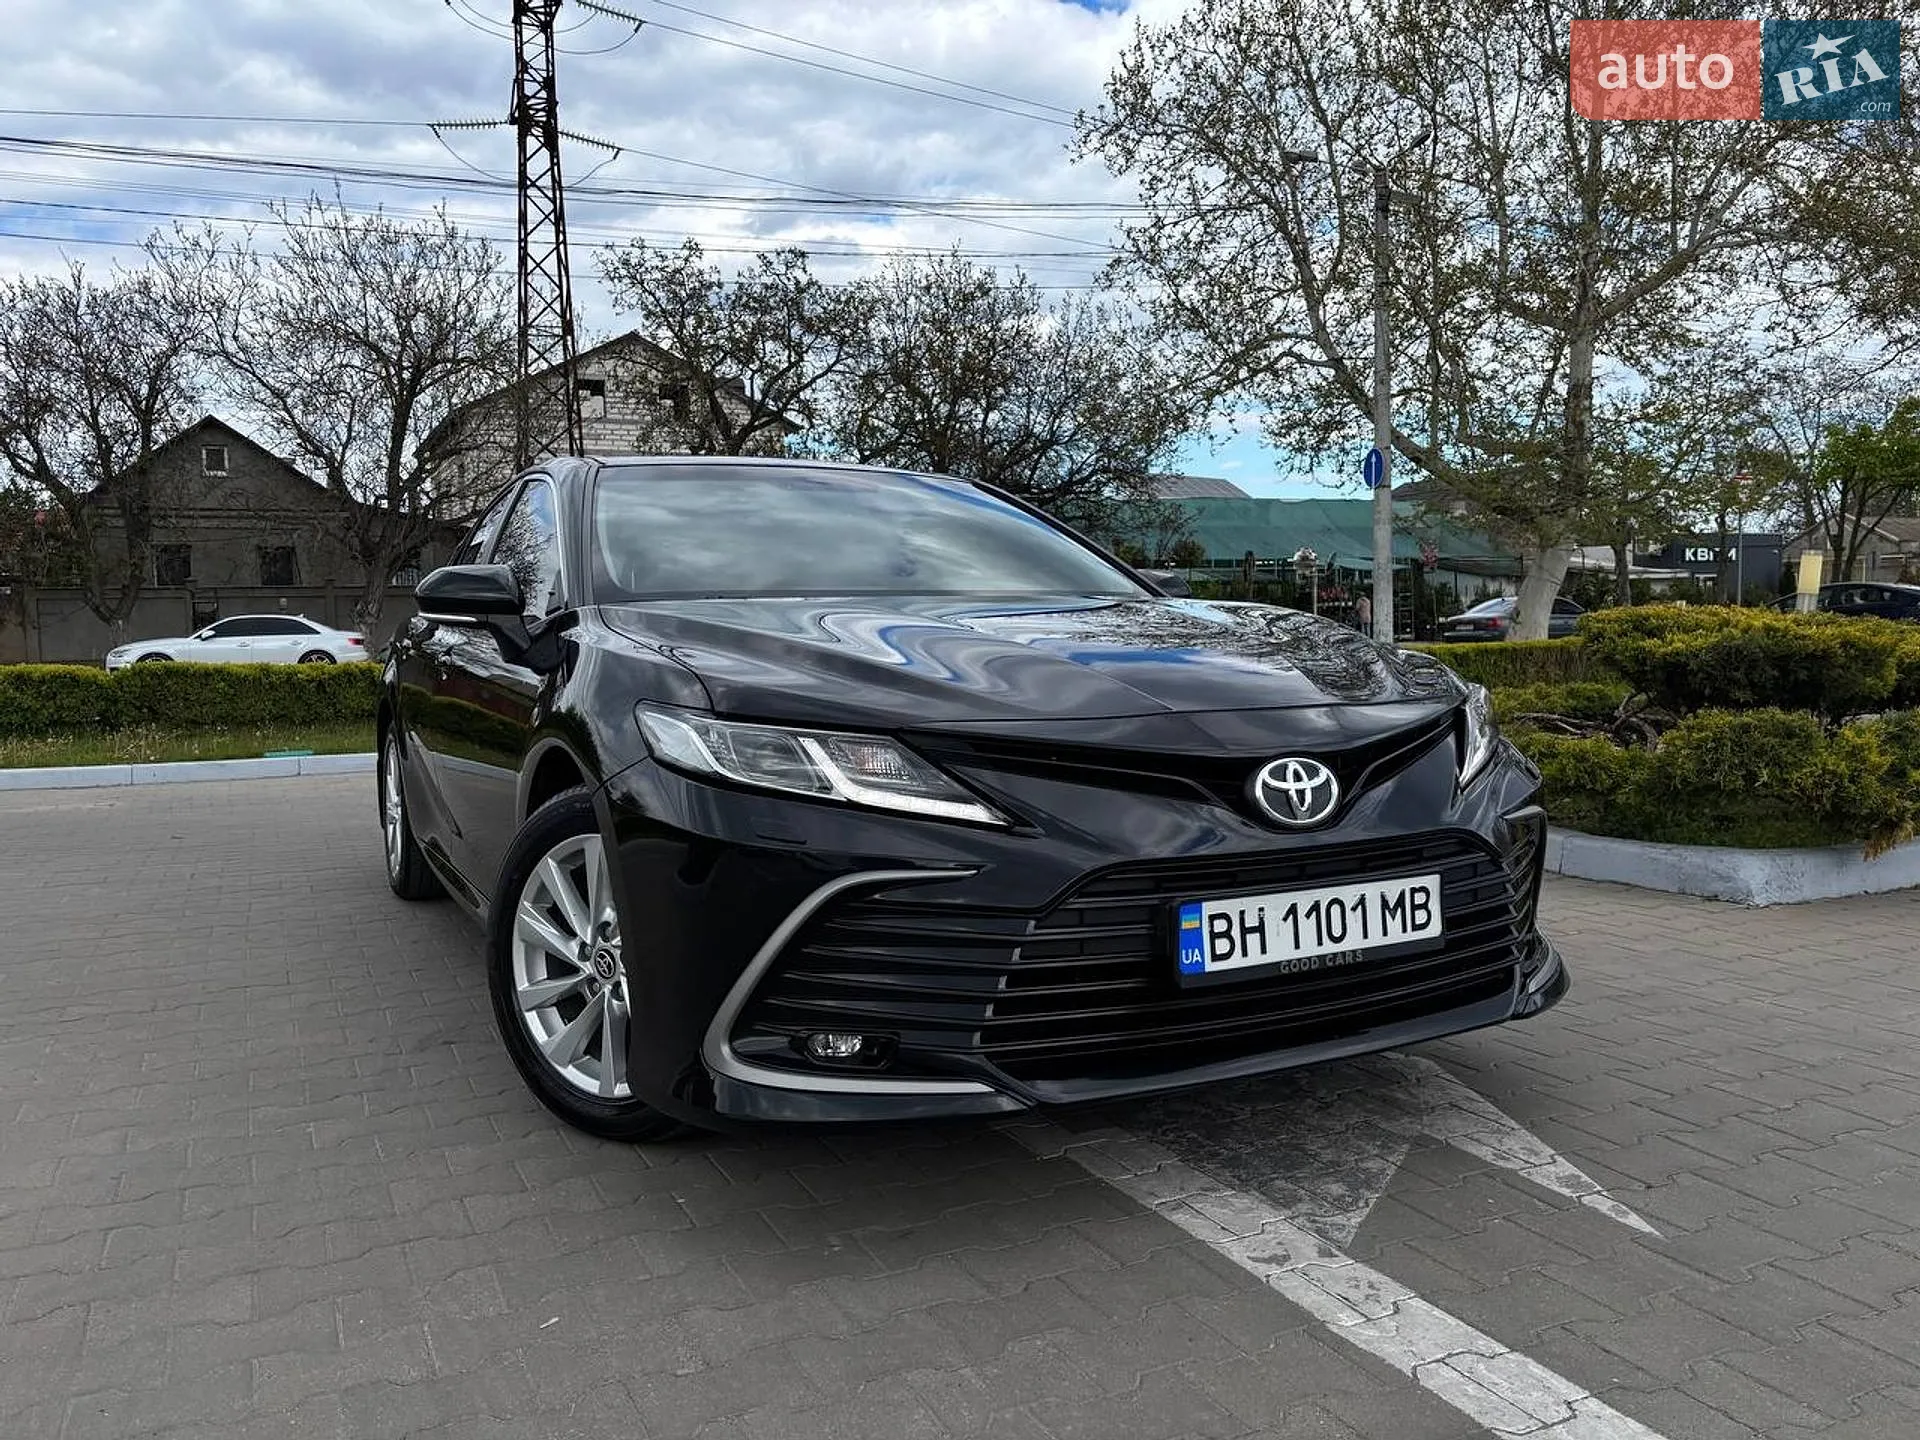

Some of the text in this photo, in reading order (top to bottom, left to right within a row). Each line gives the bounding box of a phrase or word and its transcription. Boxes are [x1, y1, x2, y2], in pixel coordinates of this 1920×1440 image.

[1208, 886, 1432, 963] BH 1101 MB
[1182, 948, 1202, 964] UA
[1280, 949, 1364, 974] GOOD CARS
